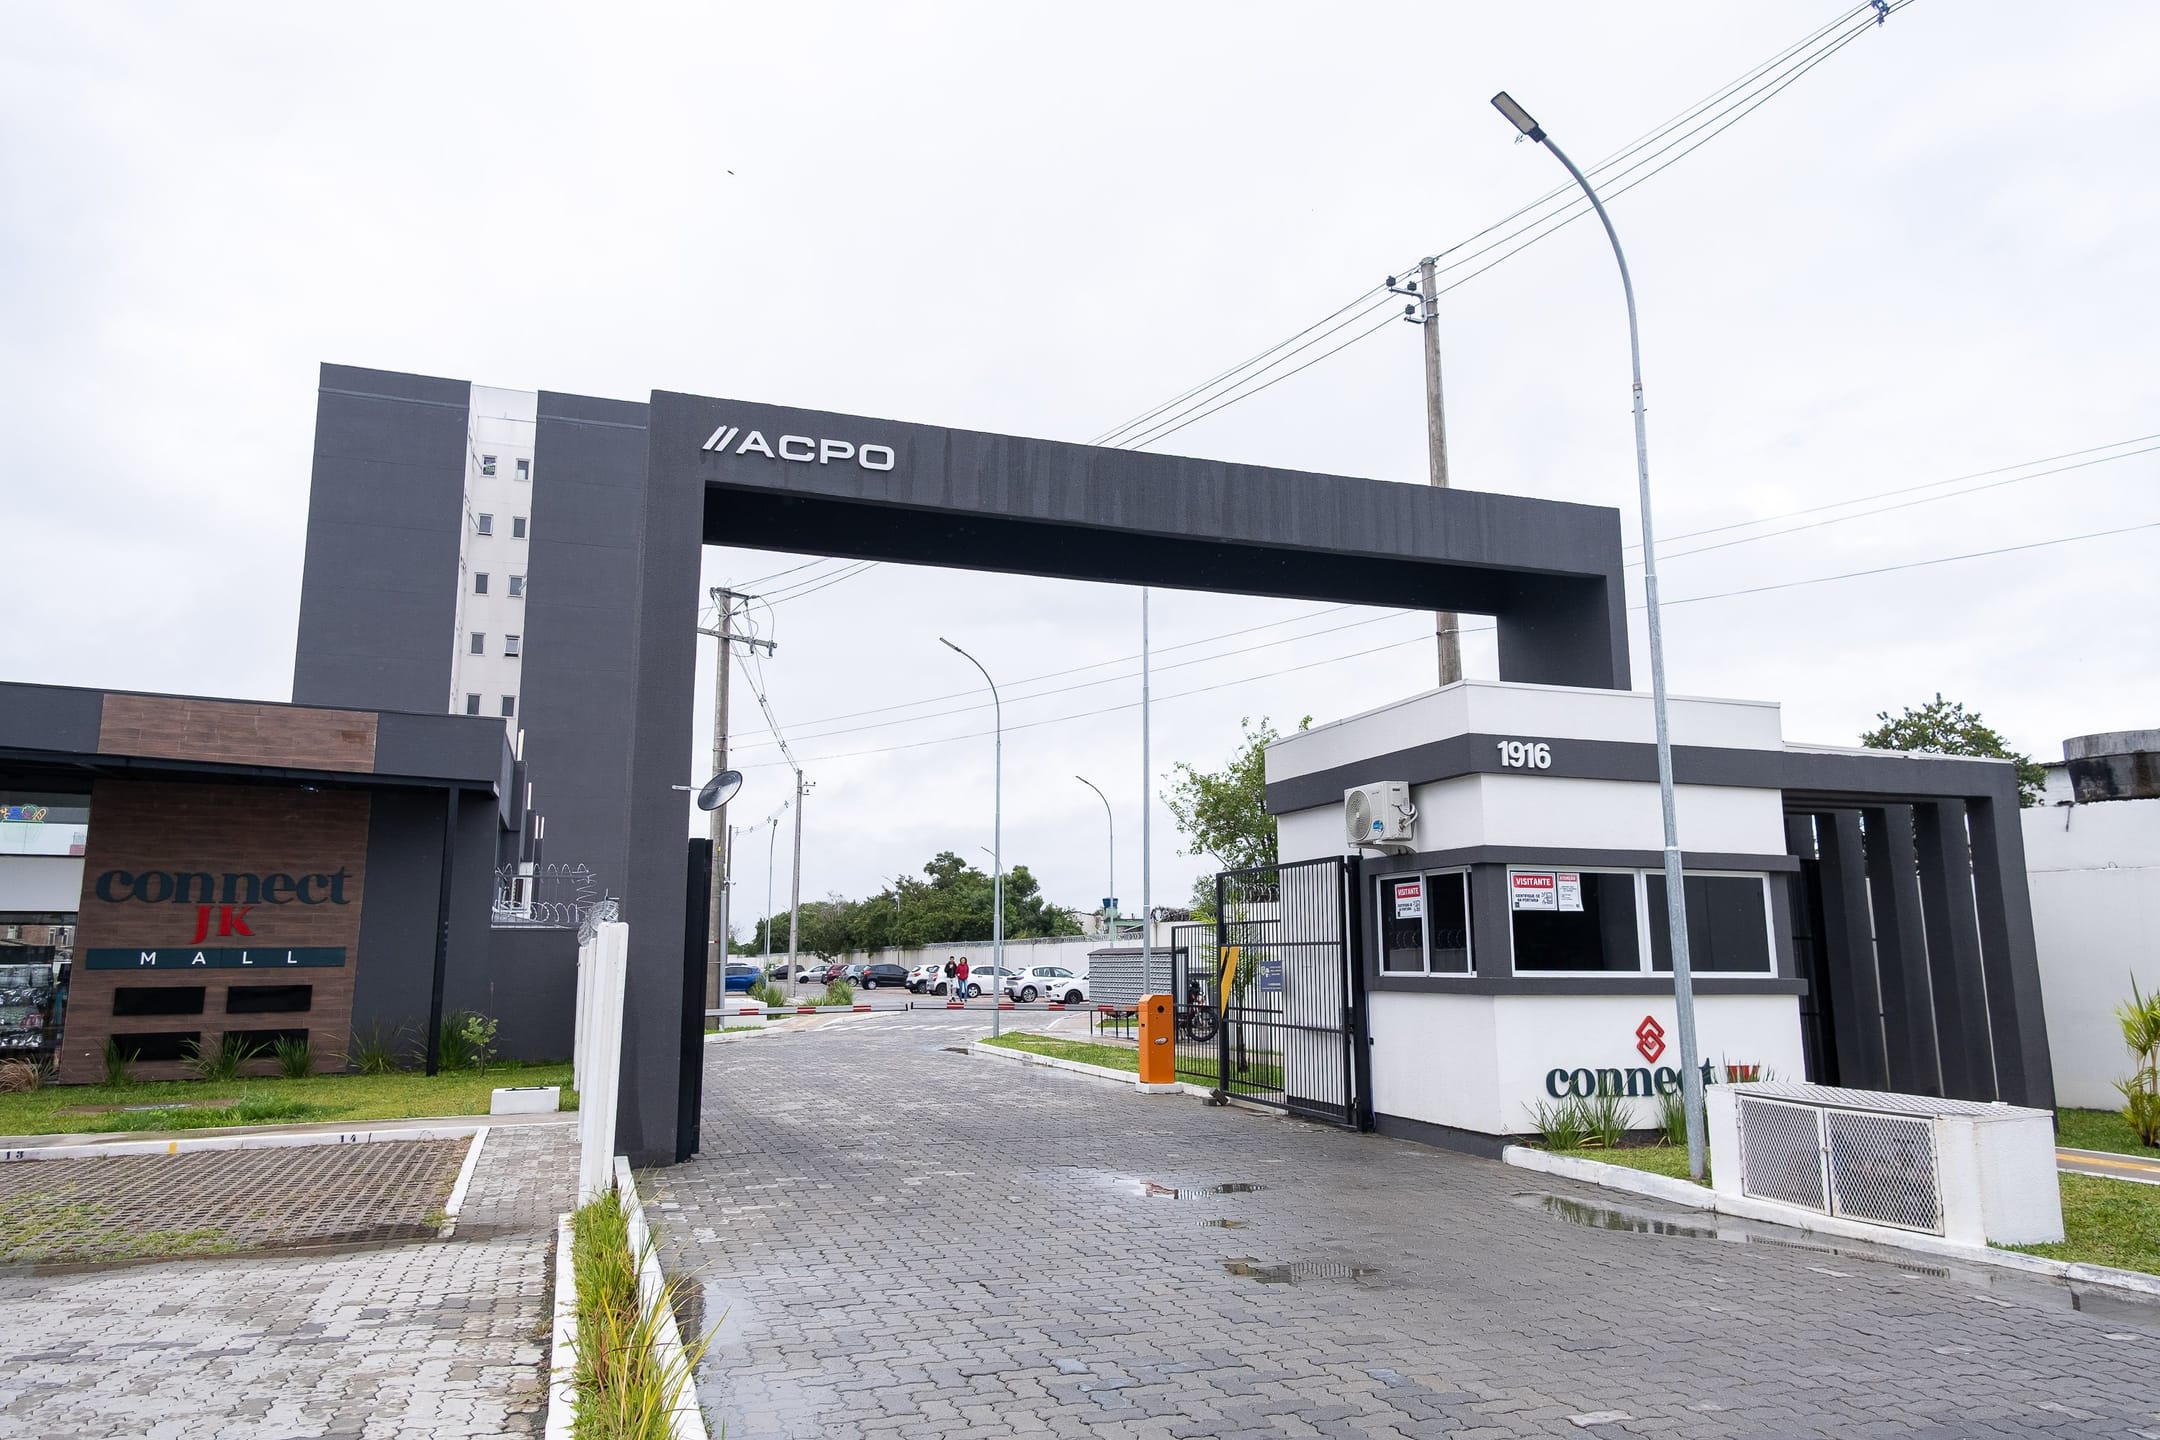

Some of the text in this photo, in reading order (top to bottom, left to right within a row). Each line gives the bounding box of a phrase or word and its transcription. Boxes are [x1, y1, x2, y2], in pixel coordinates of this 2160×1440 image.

[1497, 740, 1552, 769] 1916
[96, 866, 352, 905] connect
[1515, 877, 1551, 886] VISITANTE
[189, 905, 255, 944] JK
[140, 951, 298, 965] MALL
[1546, 1057, 1715, 1098] connet
